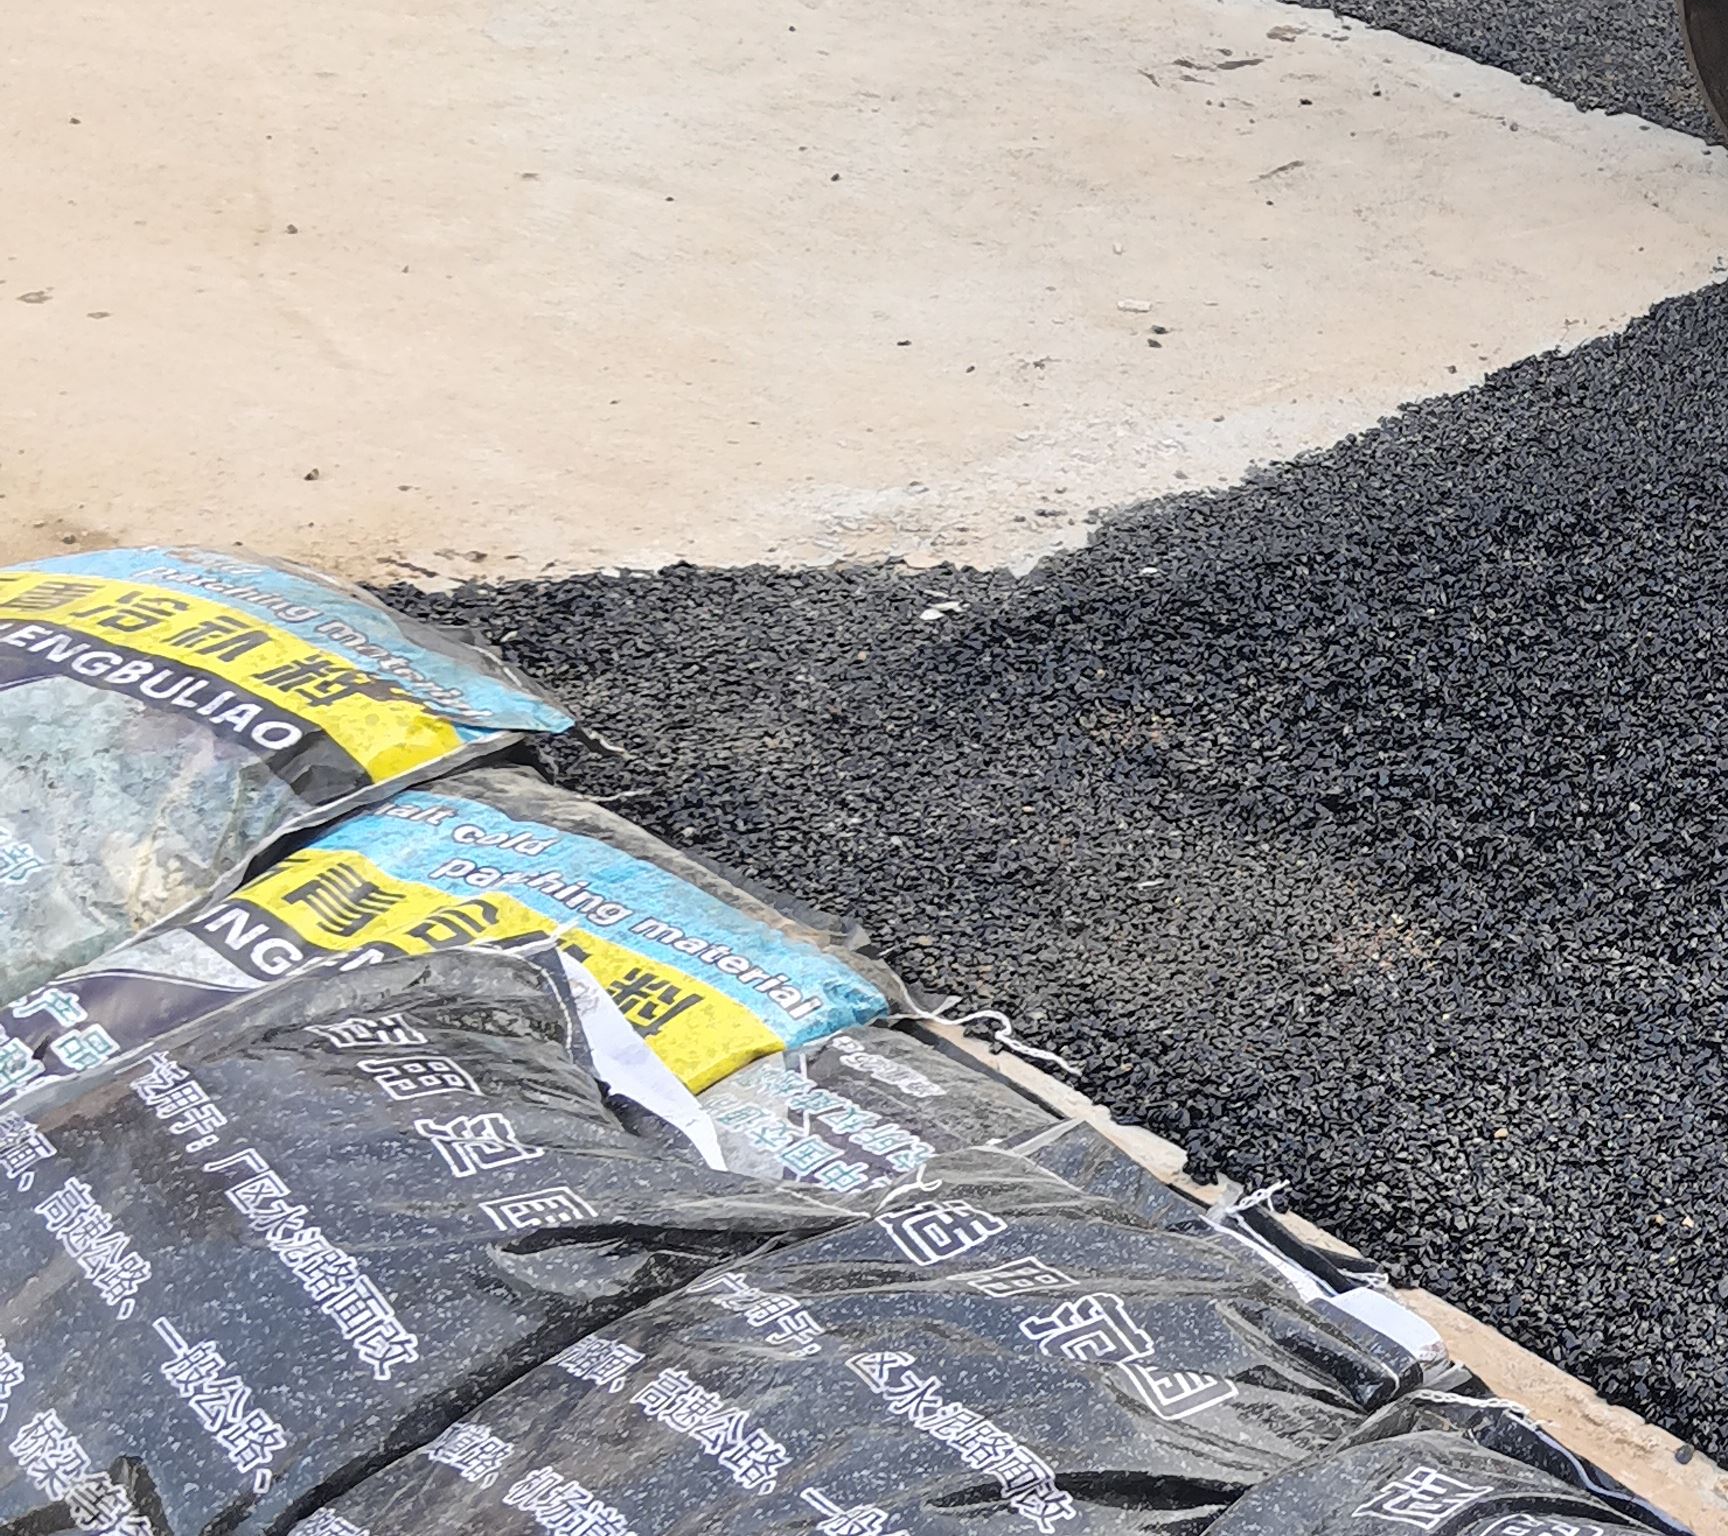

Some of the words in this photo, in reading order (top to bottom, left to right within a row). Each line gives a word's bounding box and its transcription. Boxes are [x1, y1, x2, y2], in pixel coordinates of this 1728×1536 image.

[0, 574, 442, 720] 青冷补料
[452, 816, 549, 858] cold
[629, 916, 823, 1022] material
